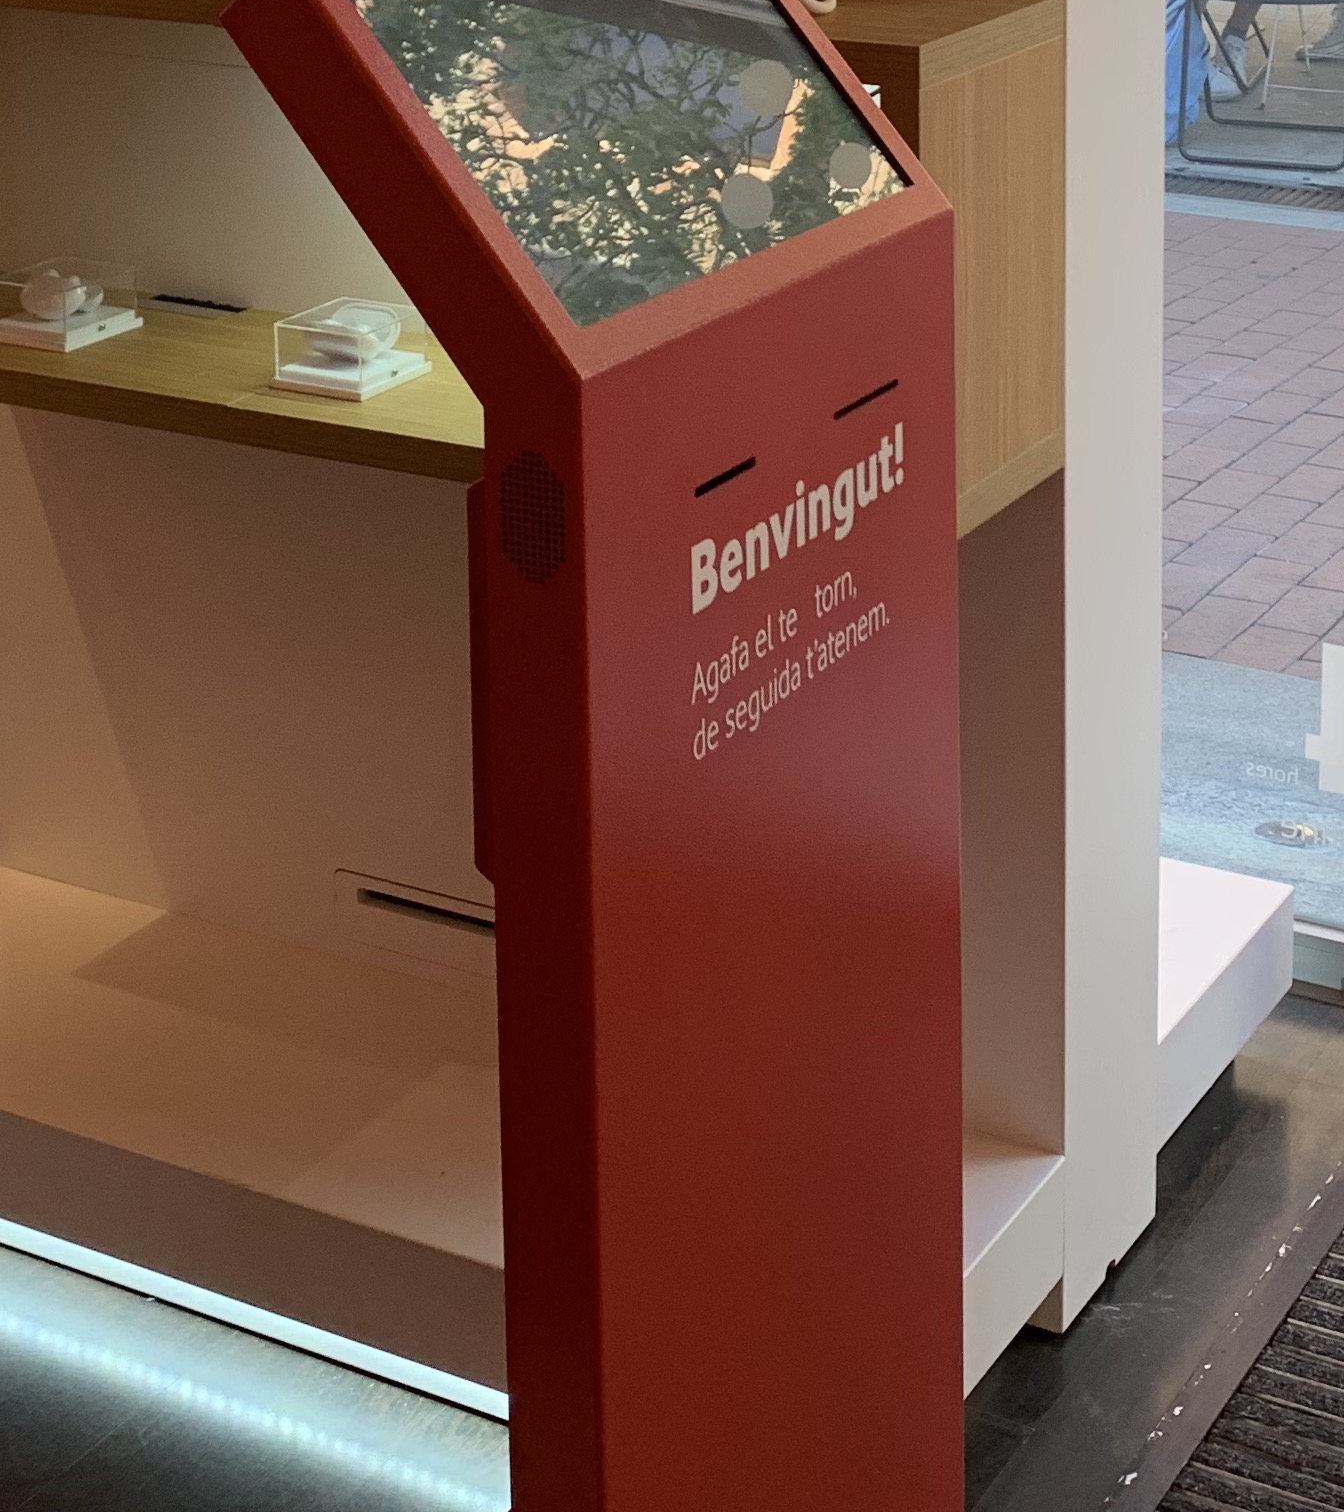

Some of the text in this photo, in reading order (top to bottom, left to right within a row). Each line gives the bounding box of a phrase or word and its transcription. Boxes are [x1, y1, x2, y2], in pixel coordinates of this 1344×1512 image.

[690, 420, 906, 616] Benvingut!
[691, 634, 750, 707] Agafa
[755, 616, 775, 659] el
[814, 569, 858, 618] torn,
[692, 599, 891, 763] de seguida t'atenem.
